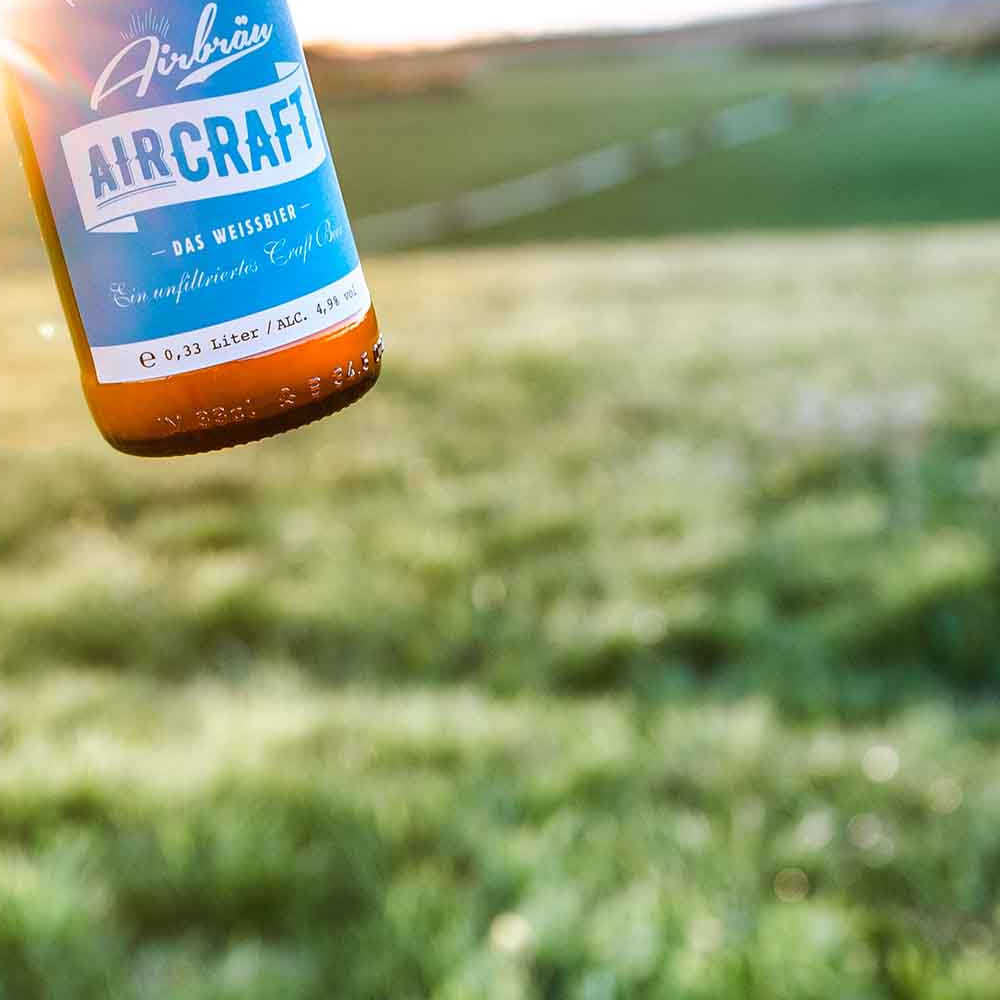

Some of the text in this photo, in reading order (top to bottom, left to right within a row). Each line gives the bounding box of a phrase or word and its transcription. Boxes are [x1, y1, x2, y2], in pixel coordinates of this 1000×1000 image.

[90, 2, 273, 112] Airbräu
[88, 84, 312, 200] AIRCRAFT
[172, 203, 297, 257] DAS WEISSBIER
[111, 282, 149, 308] Ein
[154, 262, 258, 304] unfiltriertes
[164, 343, 202, 362] 0,33
[211, 327, 260, 351] Liter
[277, 311, 308, 330] ALC.
